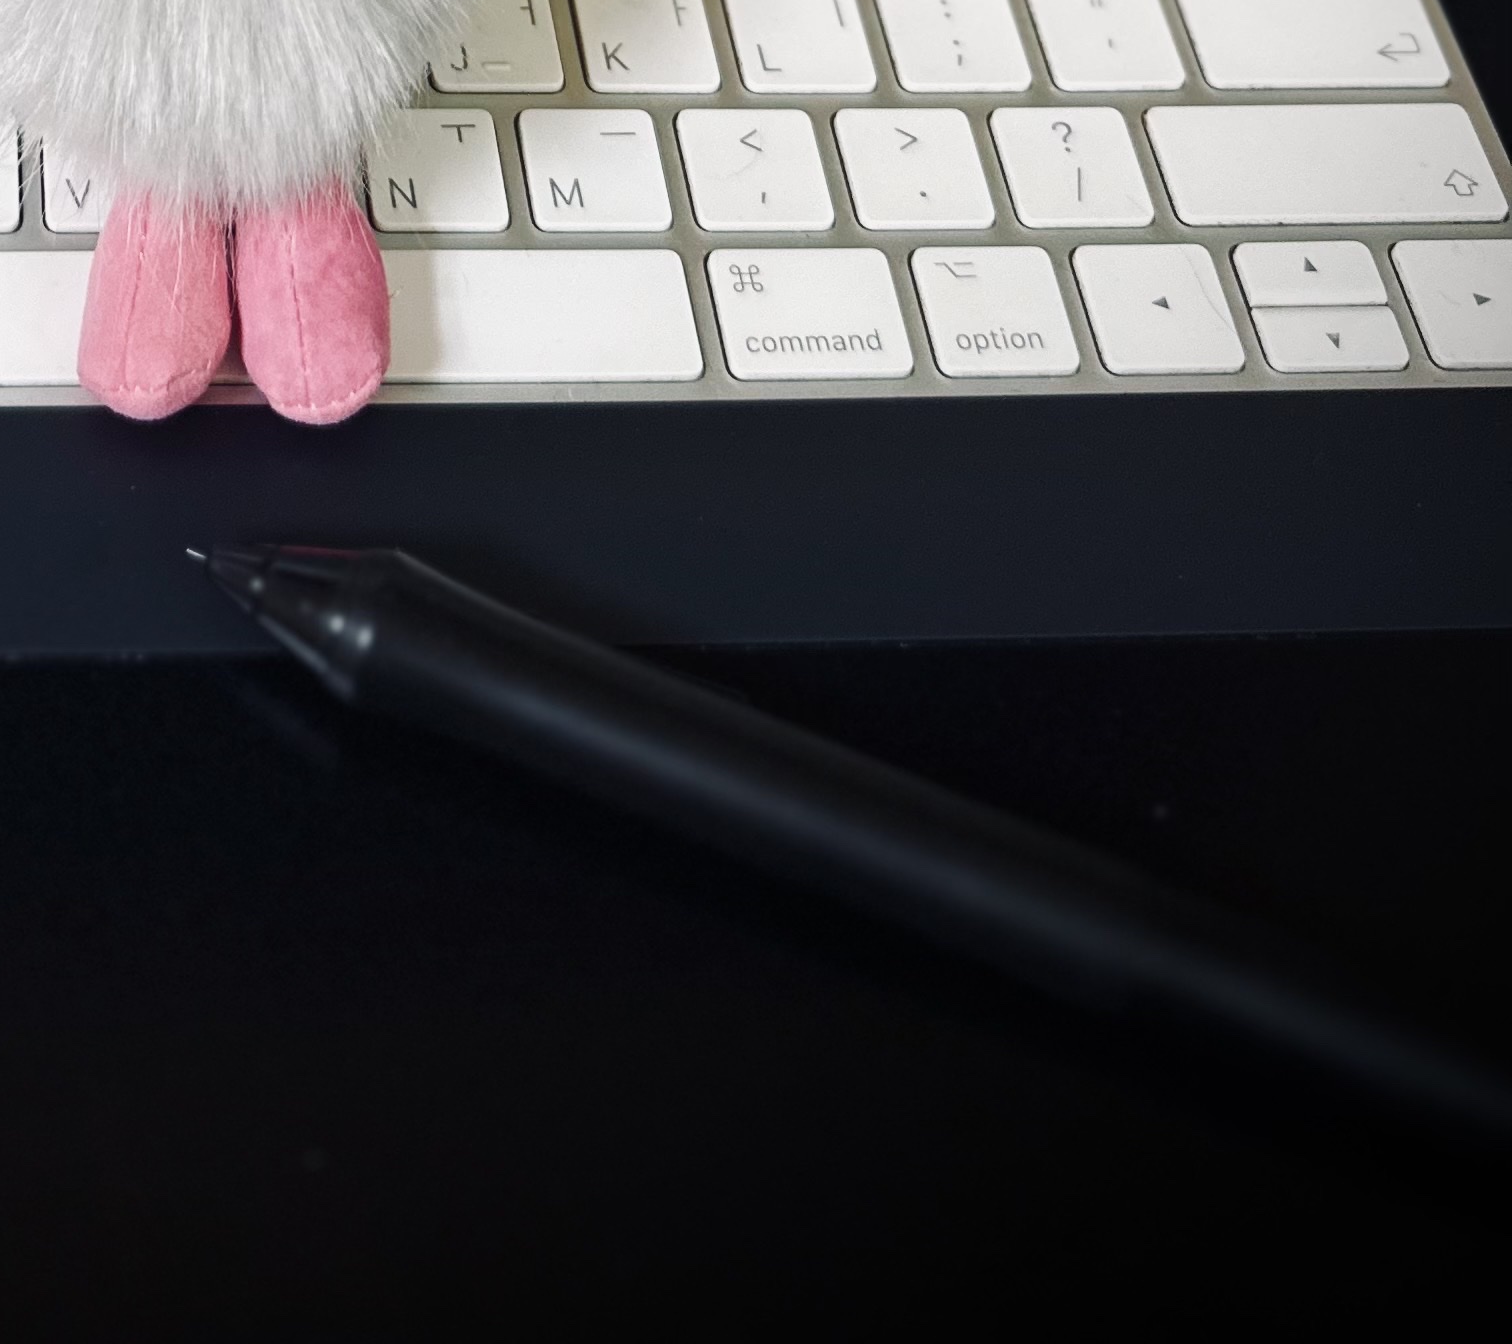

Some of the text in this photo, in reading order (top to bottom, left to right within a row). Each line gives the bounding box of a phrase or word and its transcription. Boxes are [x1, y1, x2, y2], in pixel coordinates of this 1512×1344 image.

[450, 44, 469, 72] J
[601, 41, 630, 71] K
[756, 43, 783, 73] L
[65, 178, 92, 210] V
[388, 177, 418, 210] N
[548, 177, 585, 209] M
[745, 328, 884, 354] command
[955, 327, 1045, 355] option
